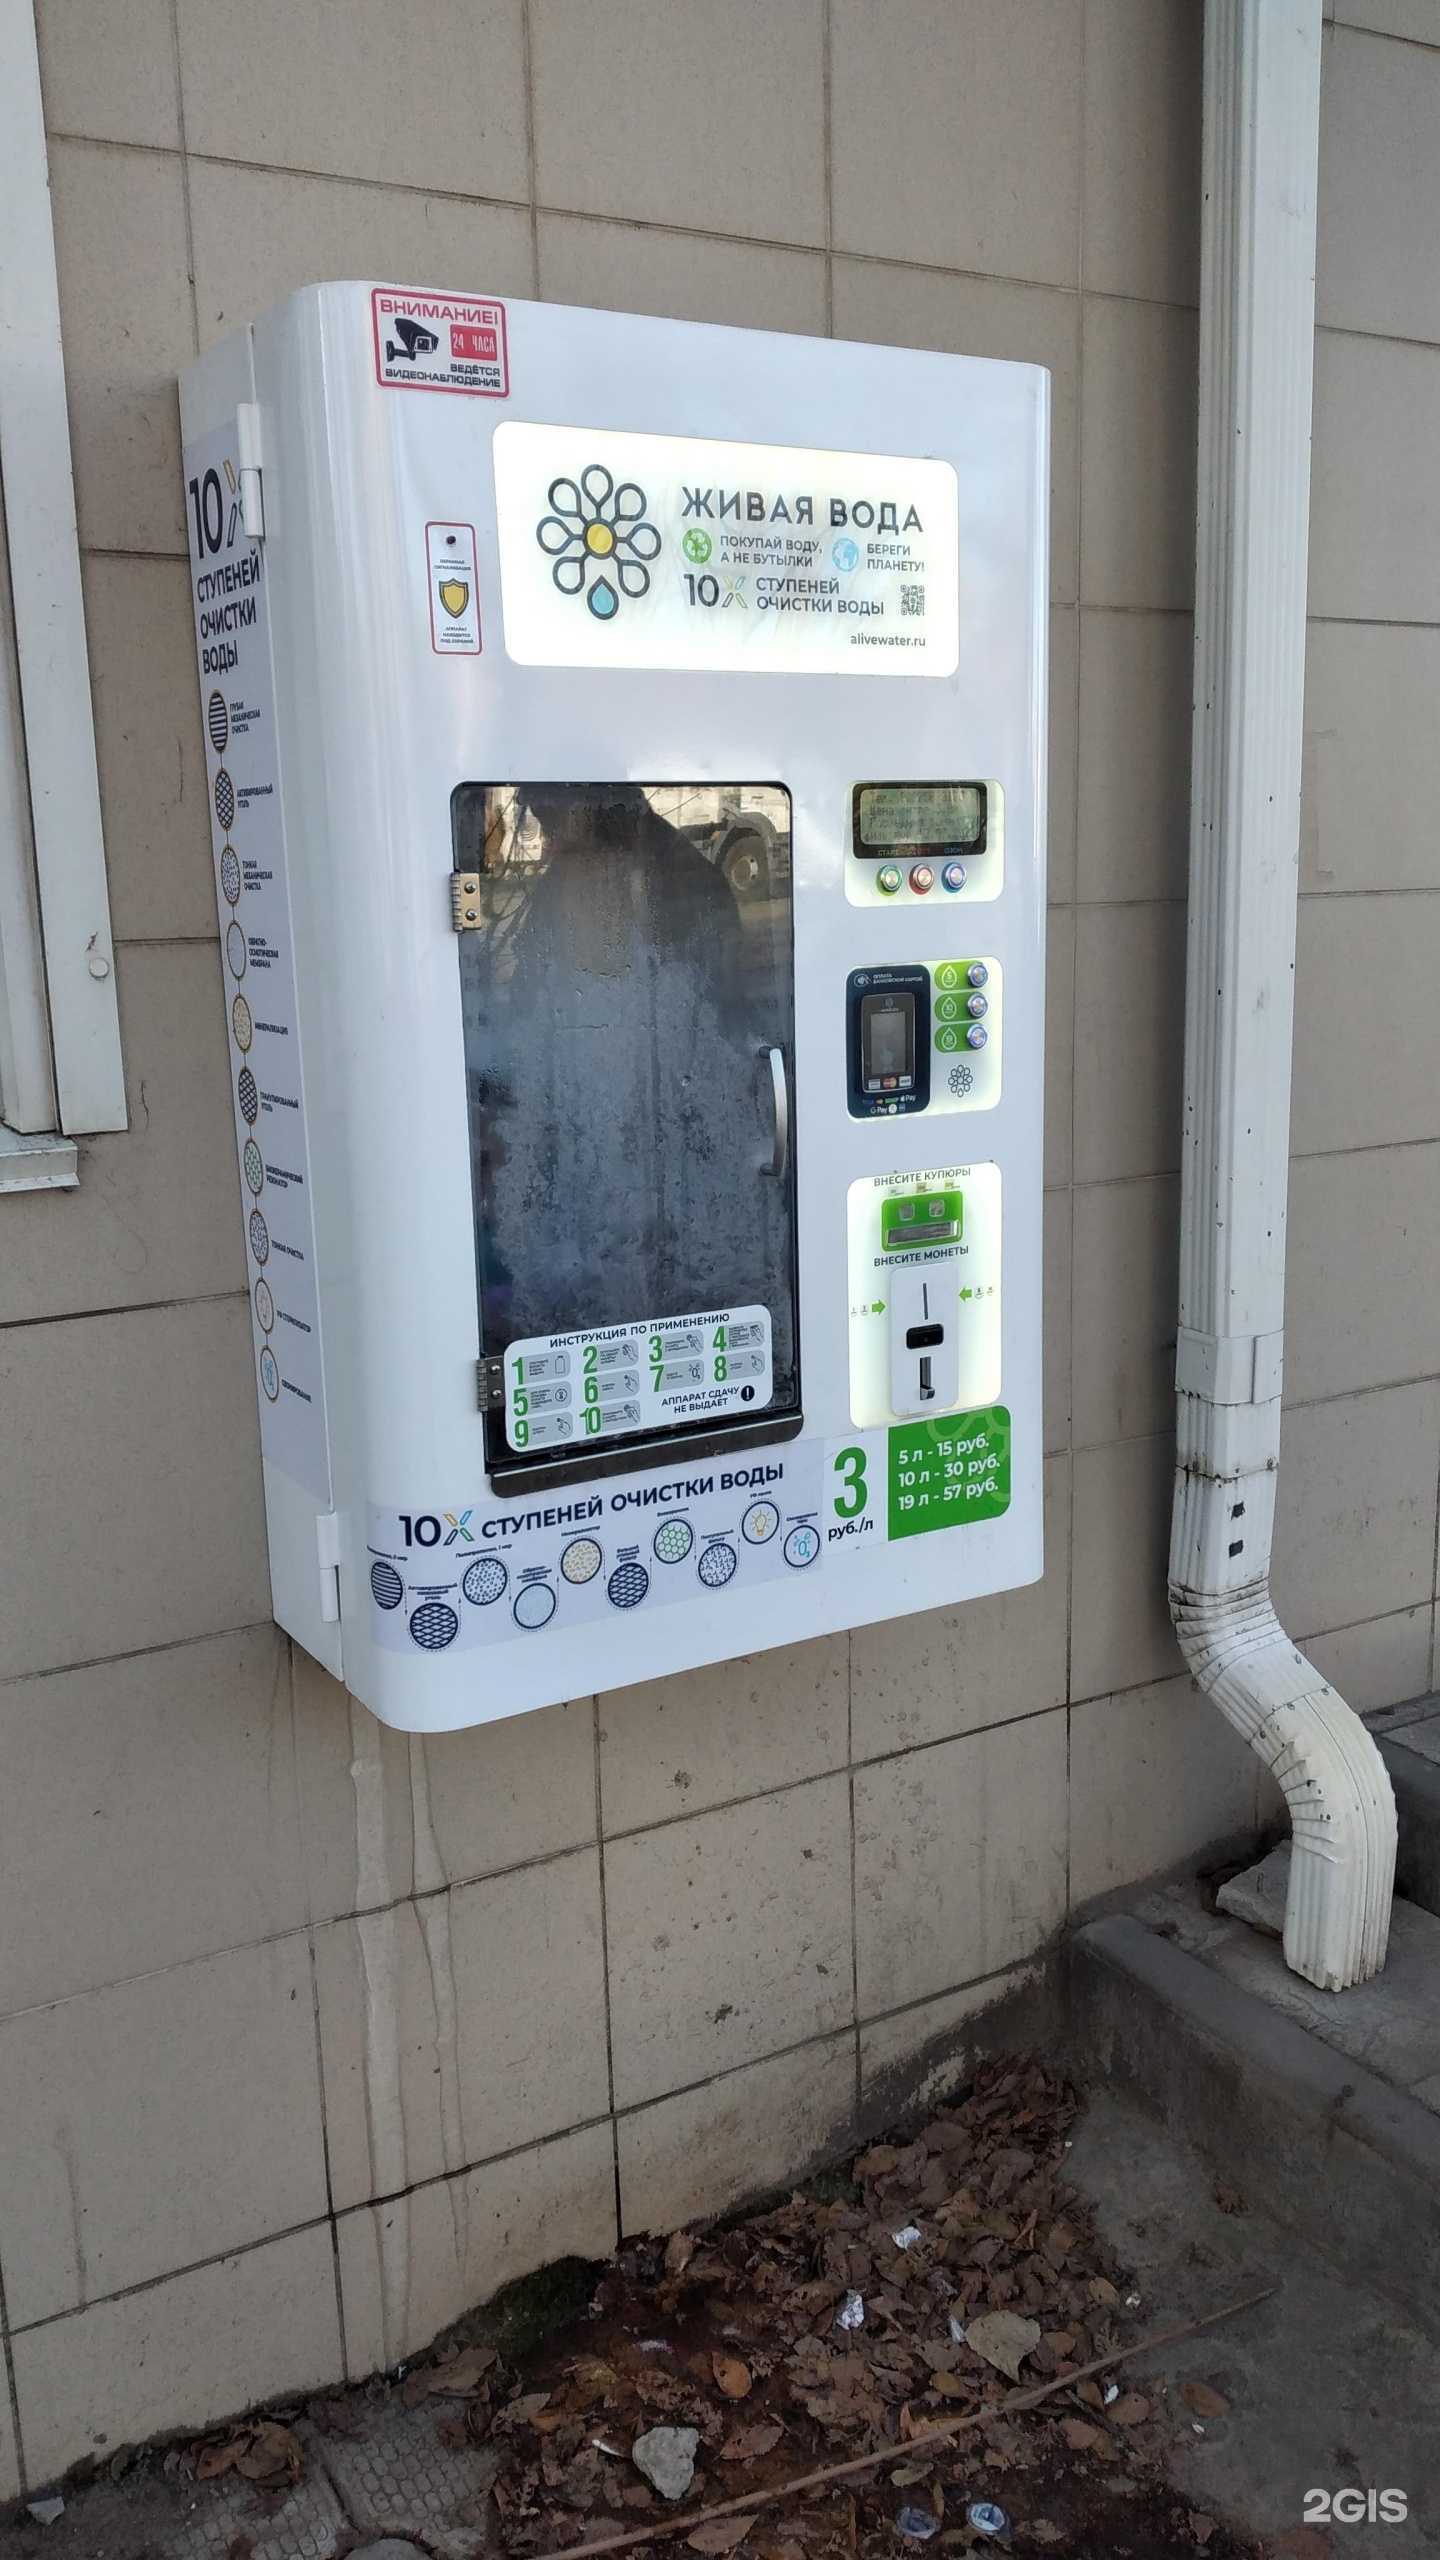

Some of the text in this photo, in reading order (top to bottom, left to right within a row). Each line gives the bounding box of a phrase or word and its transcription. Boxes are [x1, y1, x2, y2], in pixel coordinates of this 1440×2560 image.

[380, 299, 498, 325] ВНИМАНИЕ!
[452, 332, 496, 353] 24 ЧАСА
[385, 368, 501, 388] ВИДЕОНАБЛЮДЕНИЕ
[450, 363, 500, 376] ВЕДЁТСЯ
[681, 486, 924, 535] ЖИВАЯ ВОДА
[720, 535, 823, 554] ПОКУПАЙ ВОДУ,
[867, 543, 911, 556] БЕРЕГИ
[720, 554, 813, 568] А НЕ БУТЫЛКИ
[867, 560, 925, 572] ПЛАНЕТУ!
[197, 548, 261, 603] СТУПЕНЕЙ
[756, 577, 840, 594] СТУПЕНЕЙ
[200, 597, 257, 640] ОЧИСТКИ
[757, 596, 884, 617] ОЧИСТКИ ВОДЫ
[850, 633, 926, 647] alivewater.ru
[203, 640, 238, 675] ВОДЫ
[874, 1167, 971, 1187] ВНЕСИТЕ КУПЮРЫ
[874, 1245, 969, 1267] ВНЕСИТЕ МОНЕТЫ
[550, 1313, 730, 1348] ИНСТРУКЦИЯ ПО ПРИМЕНЕНИЮ
[712, 1326, 727, 1352] 4
[583, 1346, 598, 1374] 2
[648, 1335, 662, 1362] 3
[512, 1357, 524, 1385] 1
[649, 1364, 664, 1392] 7
[714, 1355, 727, 1382] 8
[513, 1388, 528, 1416] 5
[584, 1376, 598, 1404] 6
[661, 1386, 740, 1406] АППАРАТ СДАЧУ
[579, 1406, 601, 1435] 10
[674, 1404, 686, 1414] НЕ
[514, 1420, 529, 1448] 9
[898, 1450, 908, 1464] 5
[911, 1451, 922, 1462] л
[937, 1441, 952, 1457] 15
[956, 1433, 990, 1458] руб.
[834, 1446, 867, 1519] 3
[898, 1471, 915, 1487] 10
[919, 1471, 929, 1483] л
[944, 1461, 963, 1478] 30
[967, 1453, 1000, 1477] руб.
[482, 1494, 602, 1539] СТУПЕНЕЙ
[611, 1477, 714, 1512] ОЧИСТКИ
[720, 1463, 783, 1490] ВОДЫ
[898, 1495, 915, 1511] 19
[918, 1494, 929, 1506] л
[943, 1485, 961, 1501] 57
[966, 1477, 998, 1500] руб.
[828, 1517, 873, 1542] руб./л
